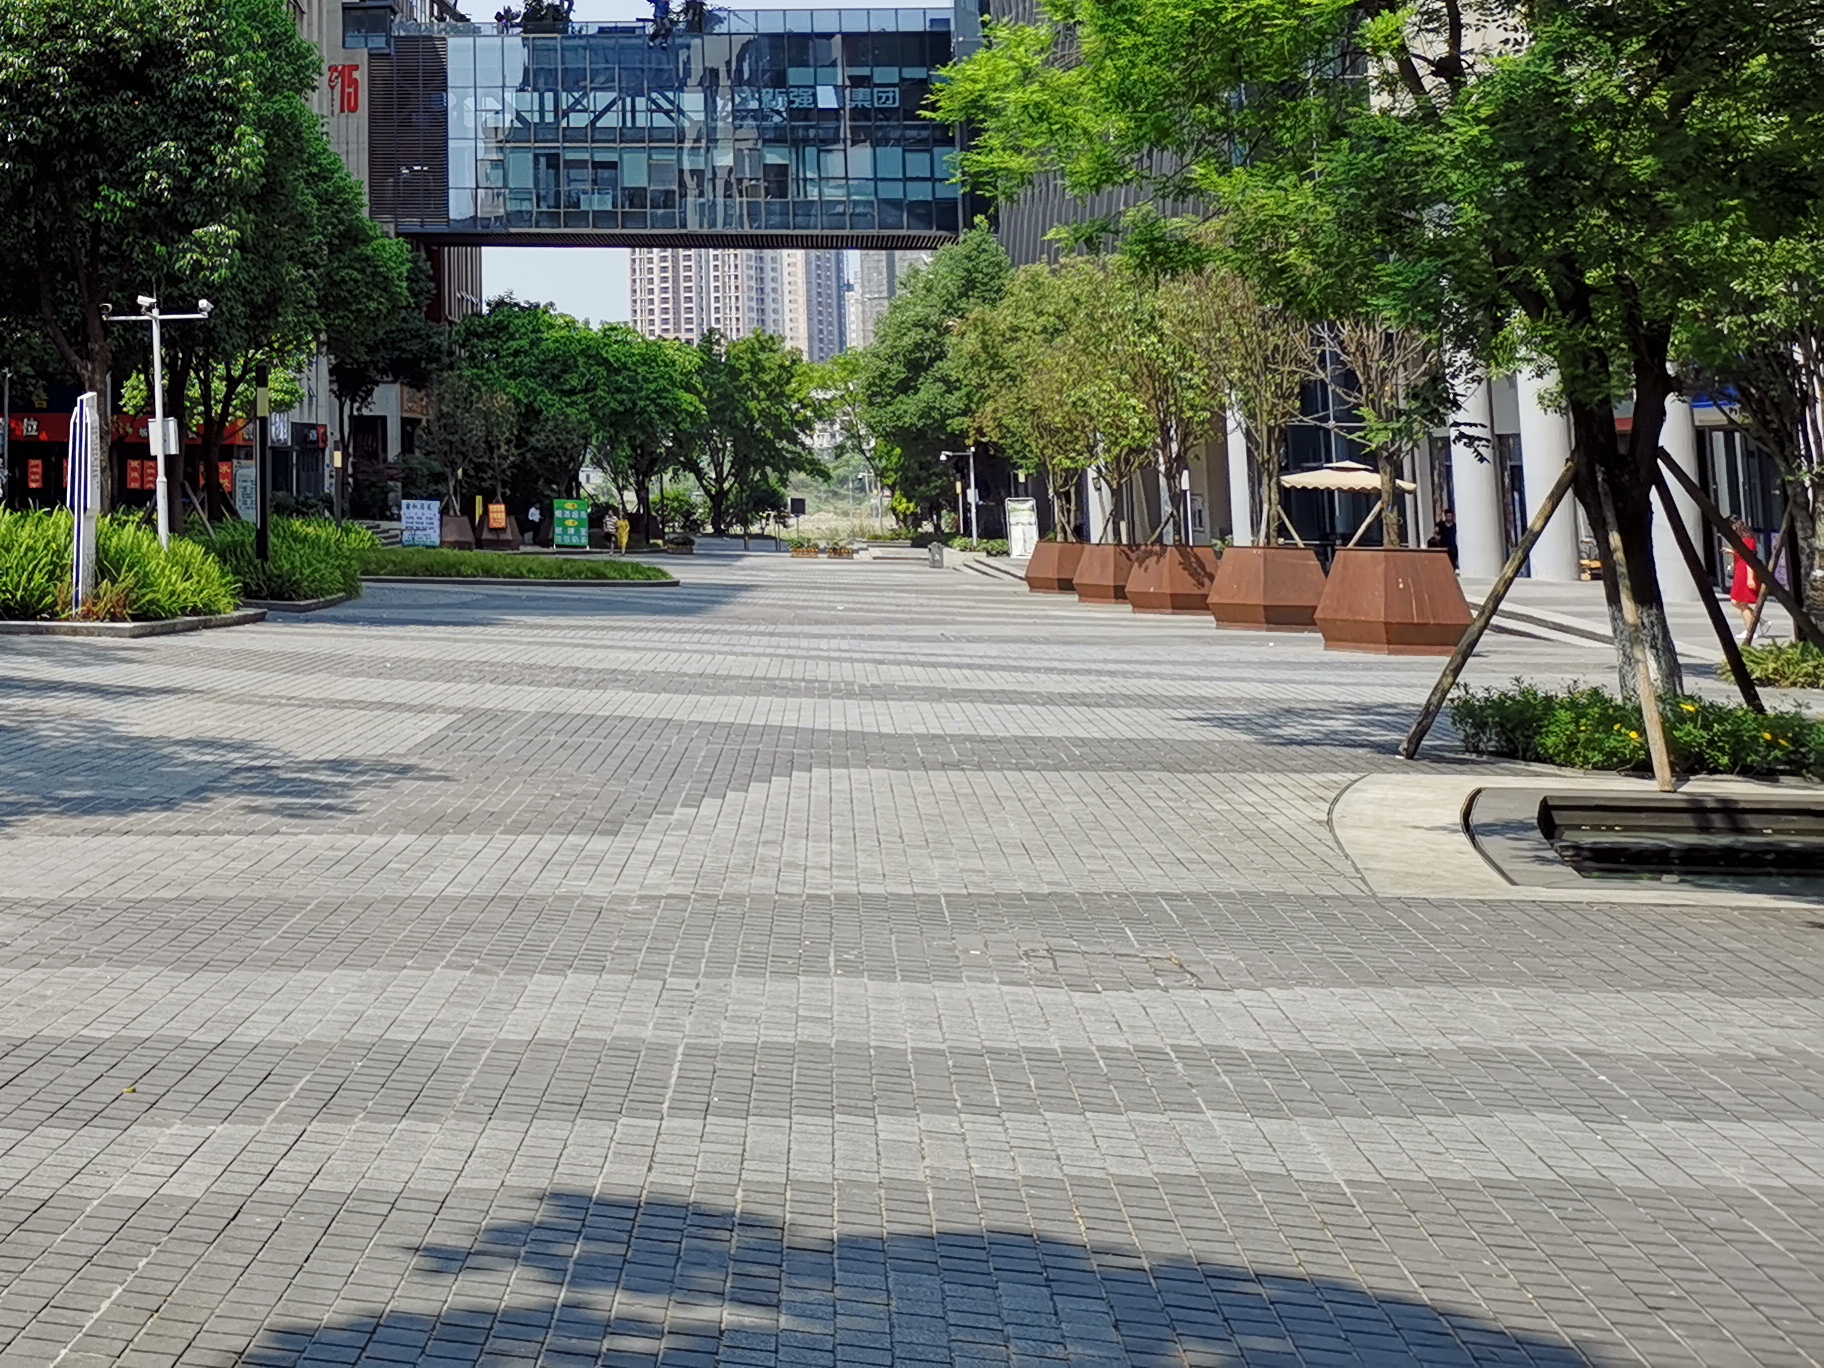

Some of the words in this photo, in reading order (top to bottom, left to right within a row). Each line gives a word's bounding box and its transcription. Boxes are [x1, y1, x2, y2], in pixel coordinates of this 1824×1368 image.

[340, 64, 359, 113] 15
[761, 87, 900, 108] 新强集团
